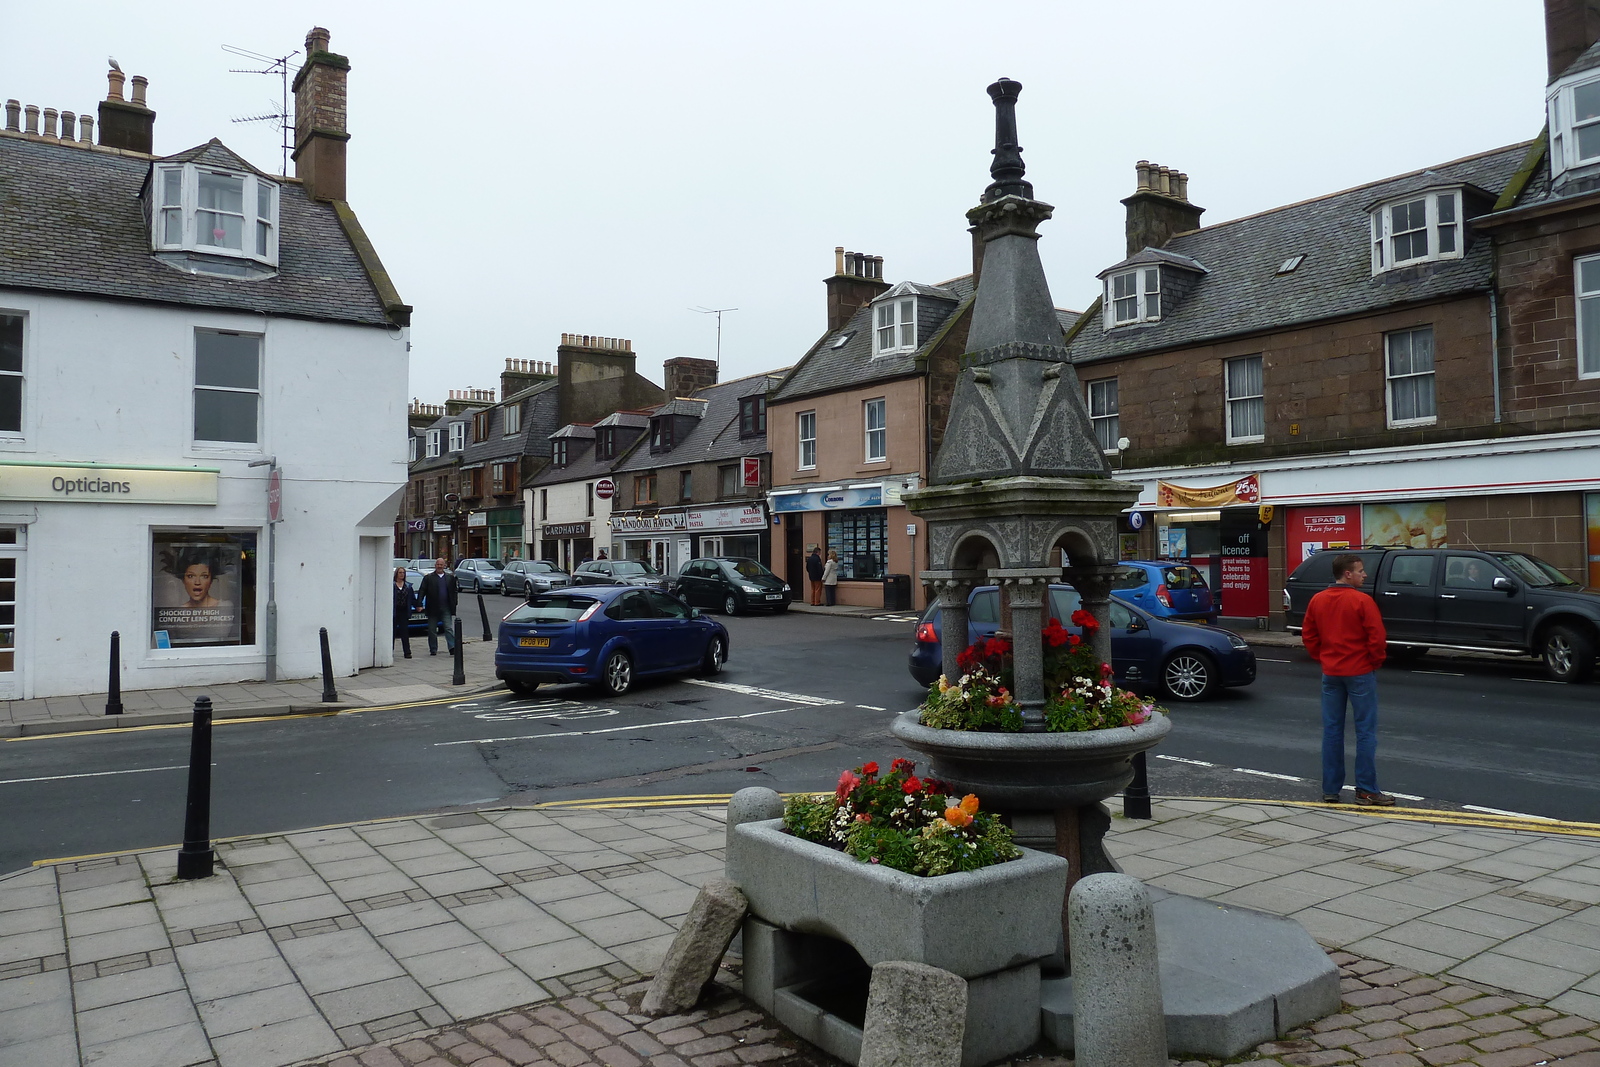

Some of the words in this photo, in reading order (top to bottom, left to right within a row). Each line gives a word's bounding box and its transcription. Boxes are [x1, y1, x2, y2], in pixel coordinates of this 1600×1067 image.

[52, 476, 130, 495] Opticians
[1235, 481, 1258, 495] 25%
[269, 488, 280, 504] STOP
[653, 517, 674, 528] HAVEN
[545, 524, 586, 535] CARDHAVEN
[1322, 525, 1333, 534] for
[1238, 533, 1250, 543] off
[1221, 545, 1250, 555] licence
[1222, 581, 1234, 589] and
[1234, 582, 1250, 590] enjoy
